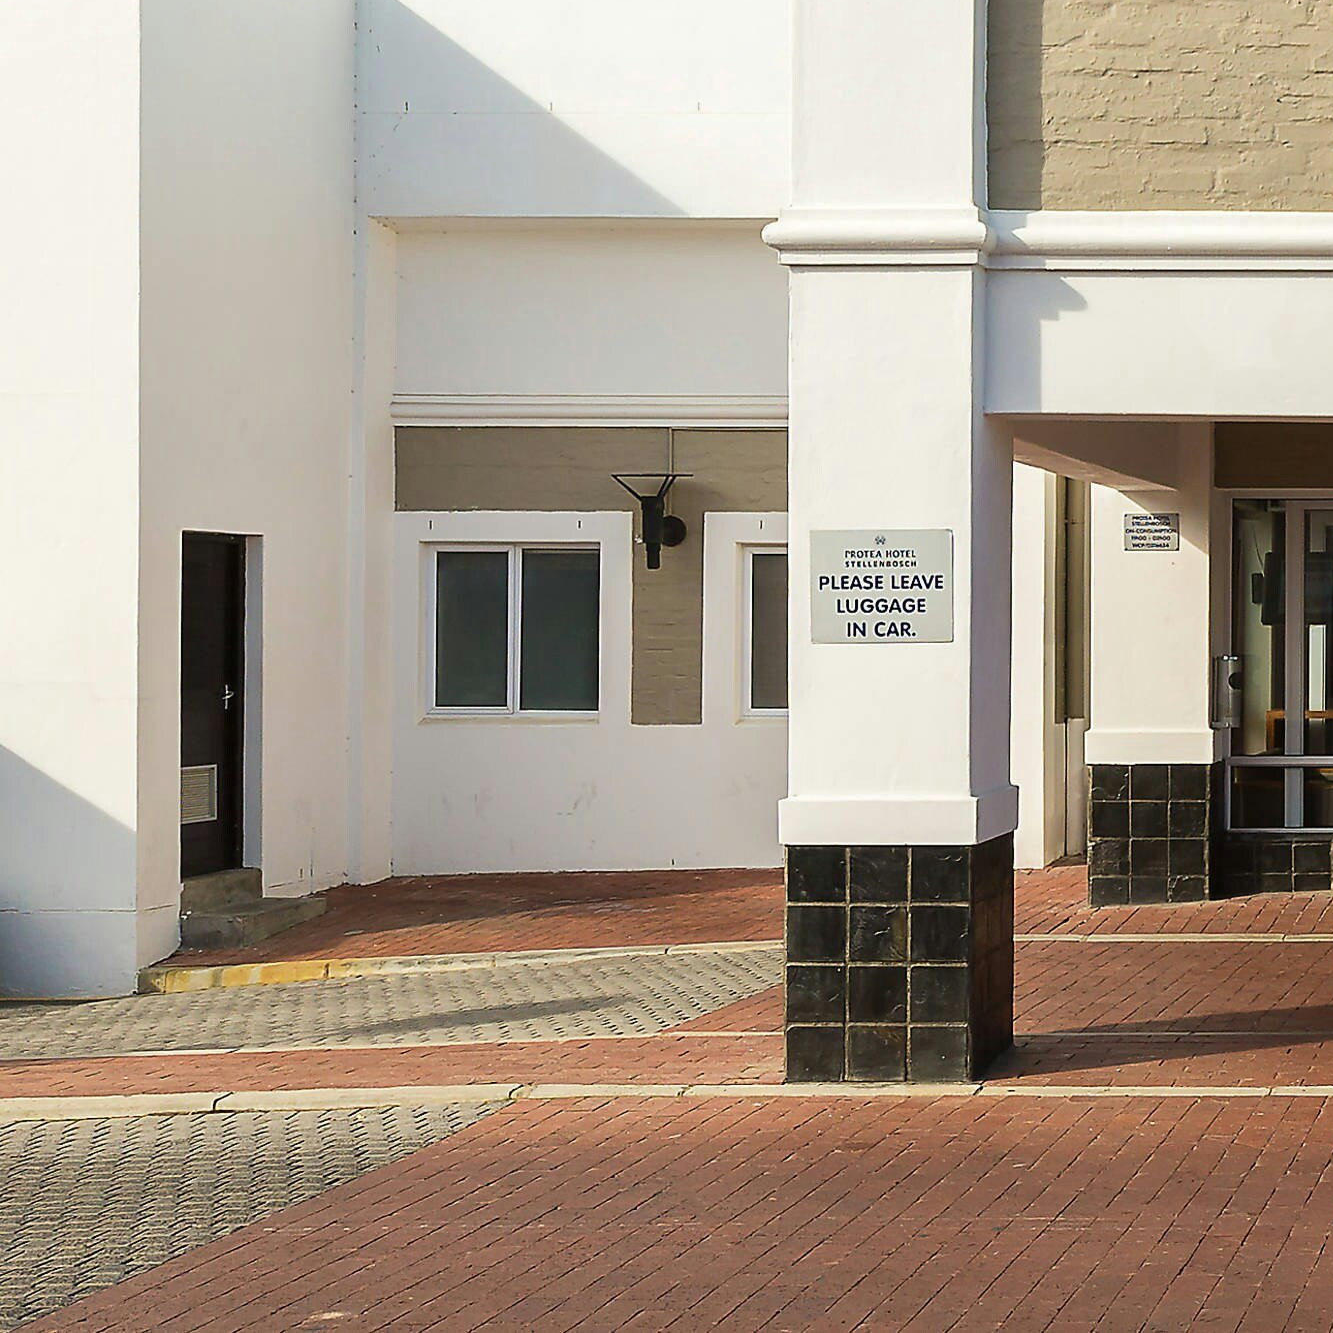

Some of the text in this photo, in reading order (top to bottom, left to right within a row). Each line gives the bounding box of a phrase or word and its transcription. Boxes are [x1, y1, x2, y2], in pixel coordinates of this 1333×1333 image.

[845, 550, 916, 558] PROTEA HOTEL
[845, 560, 917, 568] STELLENBOSCH
[819, 575, 944, 590] PLEASE LEAVE
[837, 598, 926, 613] LUGGAGE
[847, 622, 917, 637] IN CAR.
